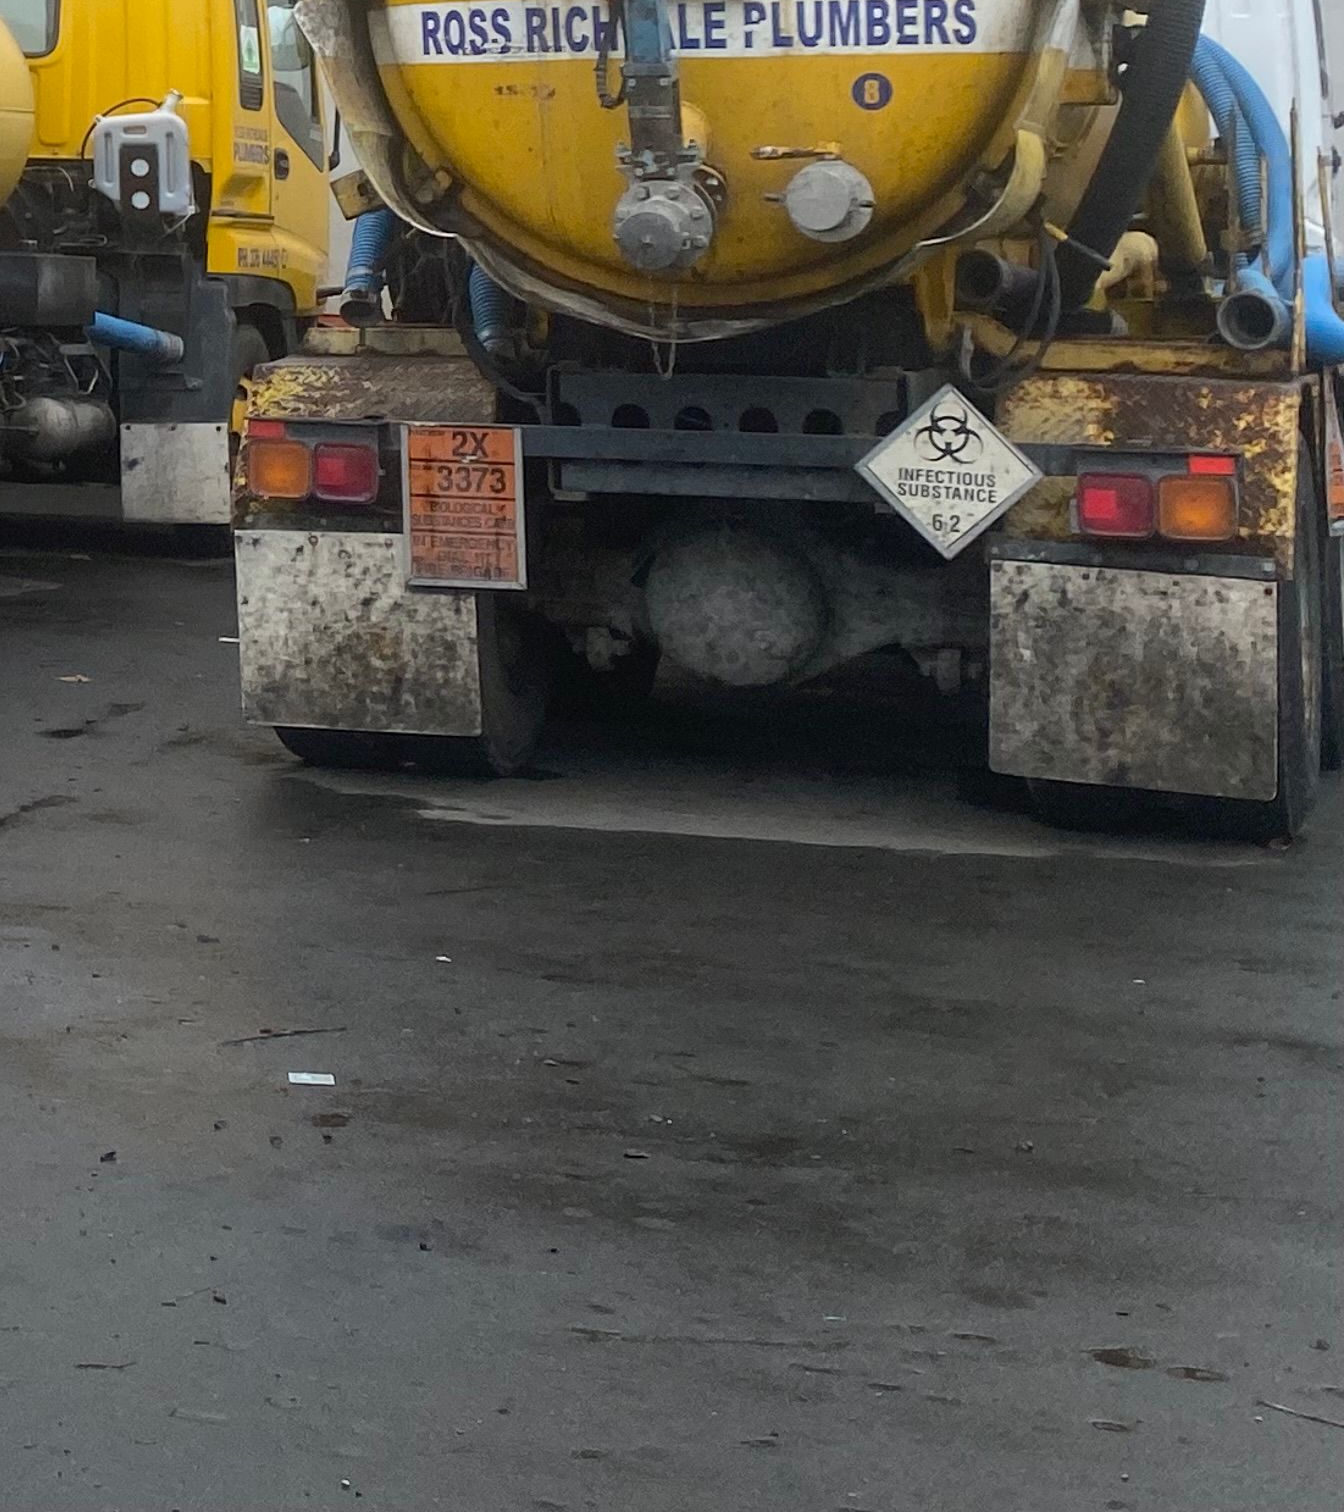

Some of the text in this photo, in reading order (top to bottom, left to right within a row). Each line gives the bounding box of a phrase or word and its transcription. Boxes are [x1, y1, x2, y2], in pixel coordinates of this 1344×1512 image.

[421, 8, 512, 56] ROSS
[525, 1, 728, 54] RICHLE
[452, 431, 489, 458] 2X
[437, 465, 507, 494] 3373
[898, 467, 996, 488] INFECTIOUS
[897, 483, 997, 504] SUBSTANCE
